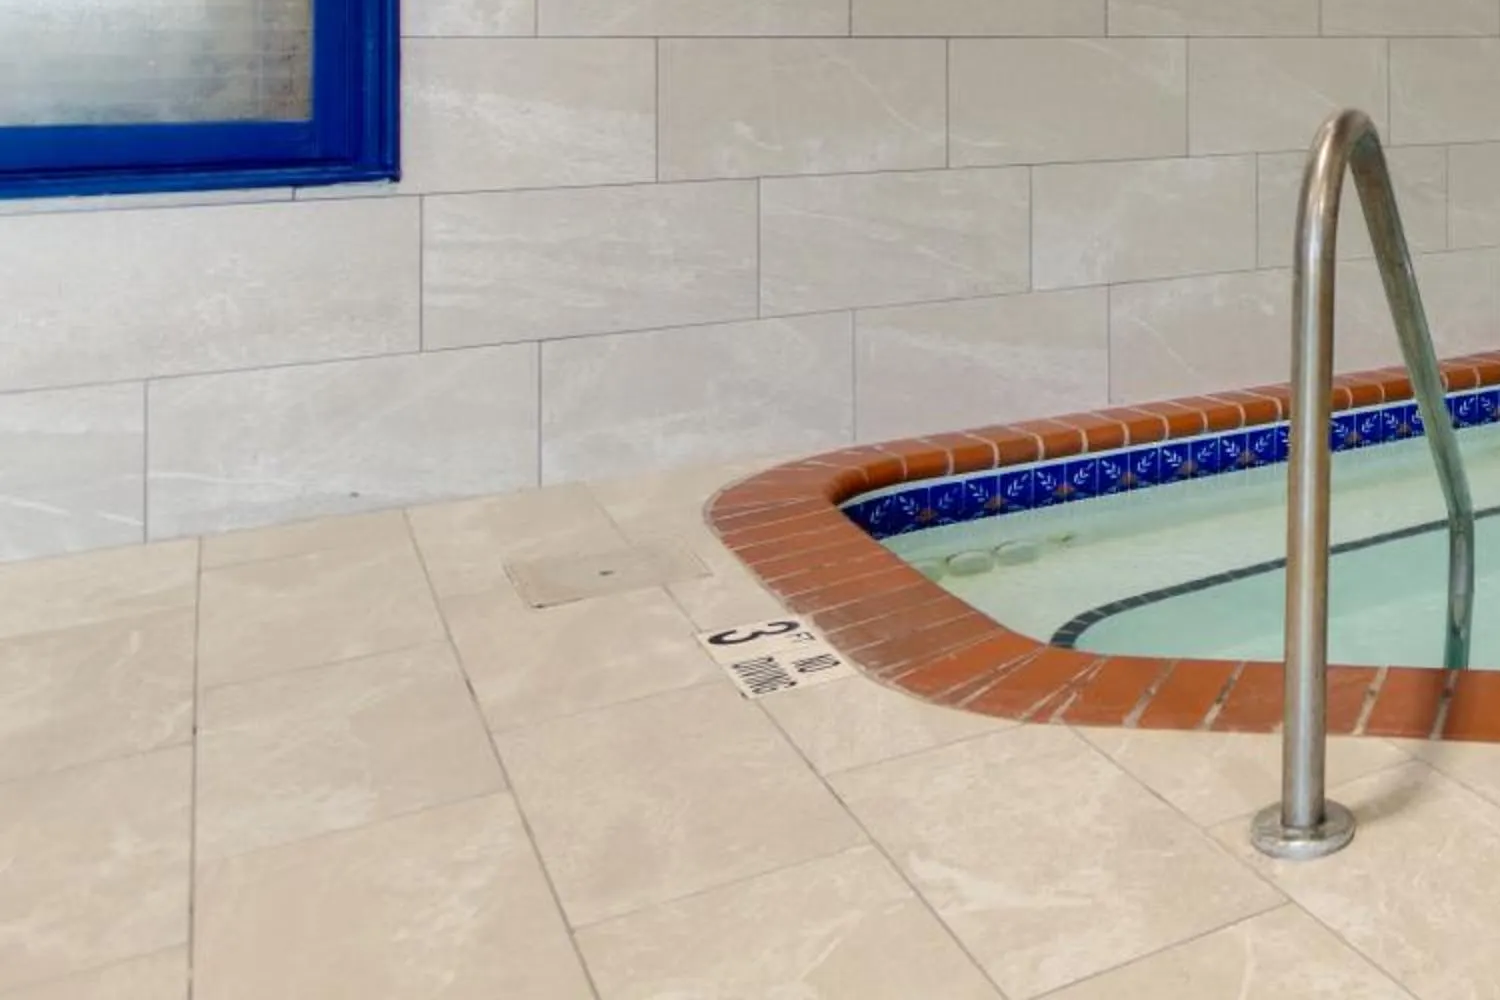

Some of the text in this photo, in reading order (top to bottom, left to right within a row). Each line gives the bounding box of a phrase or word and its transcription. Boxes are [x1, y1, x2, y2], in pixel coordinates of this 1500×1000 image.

[708, 621, 800, 645] 3
[731, 655, 798, 695] DIVING
[791, 653, 842, 673] NO
